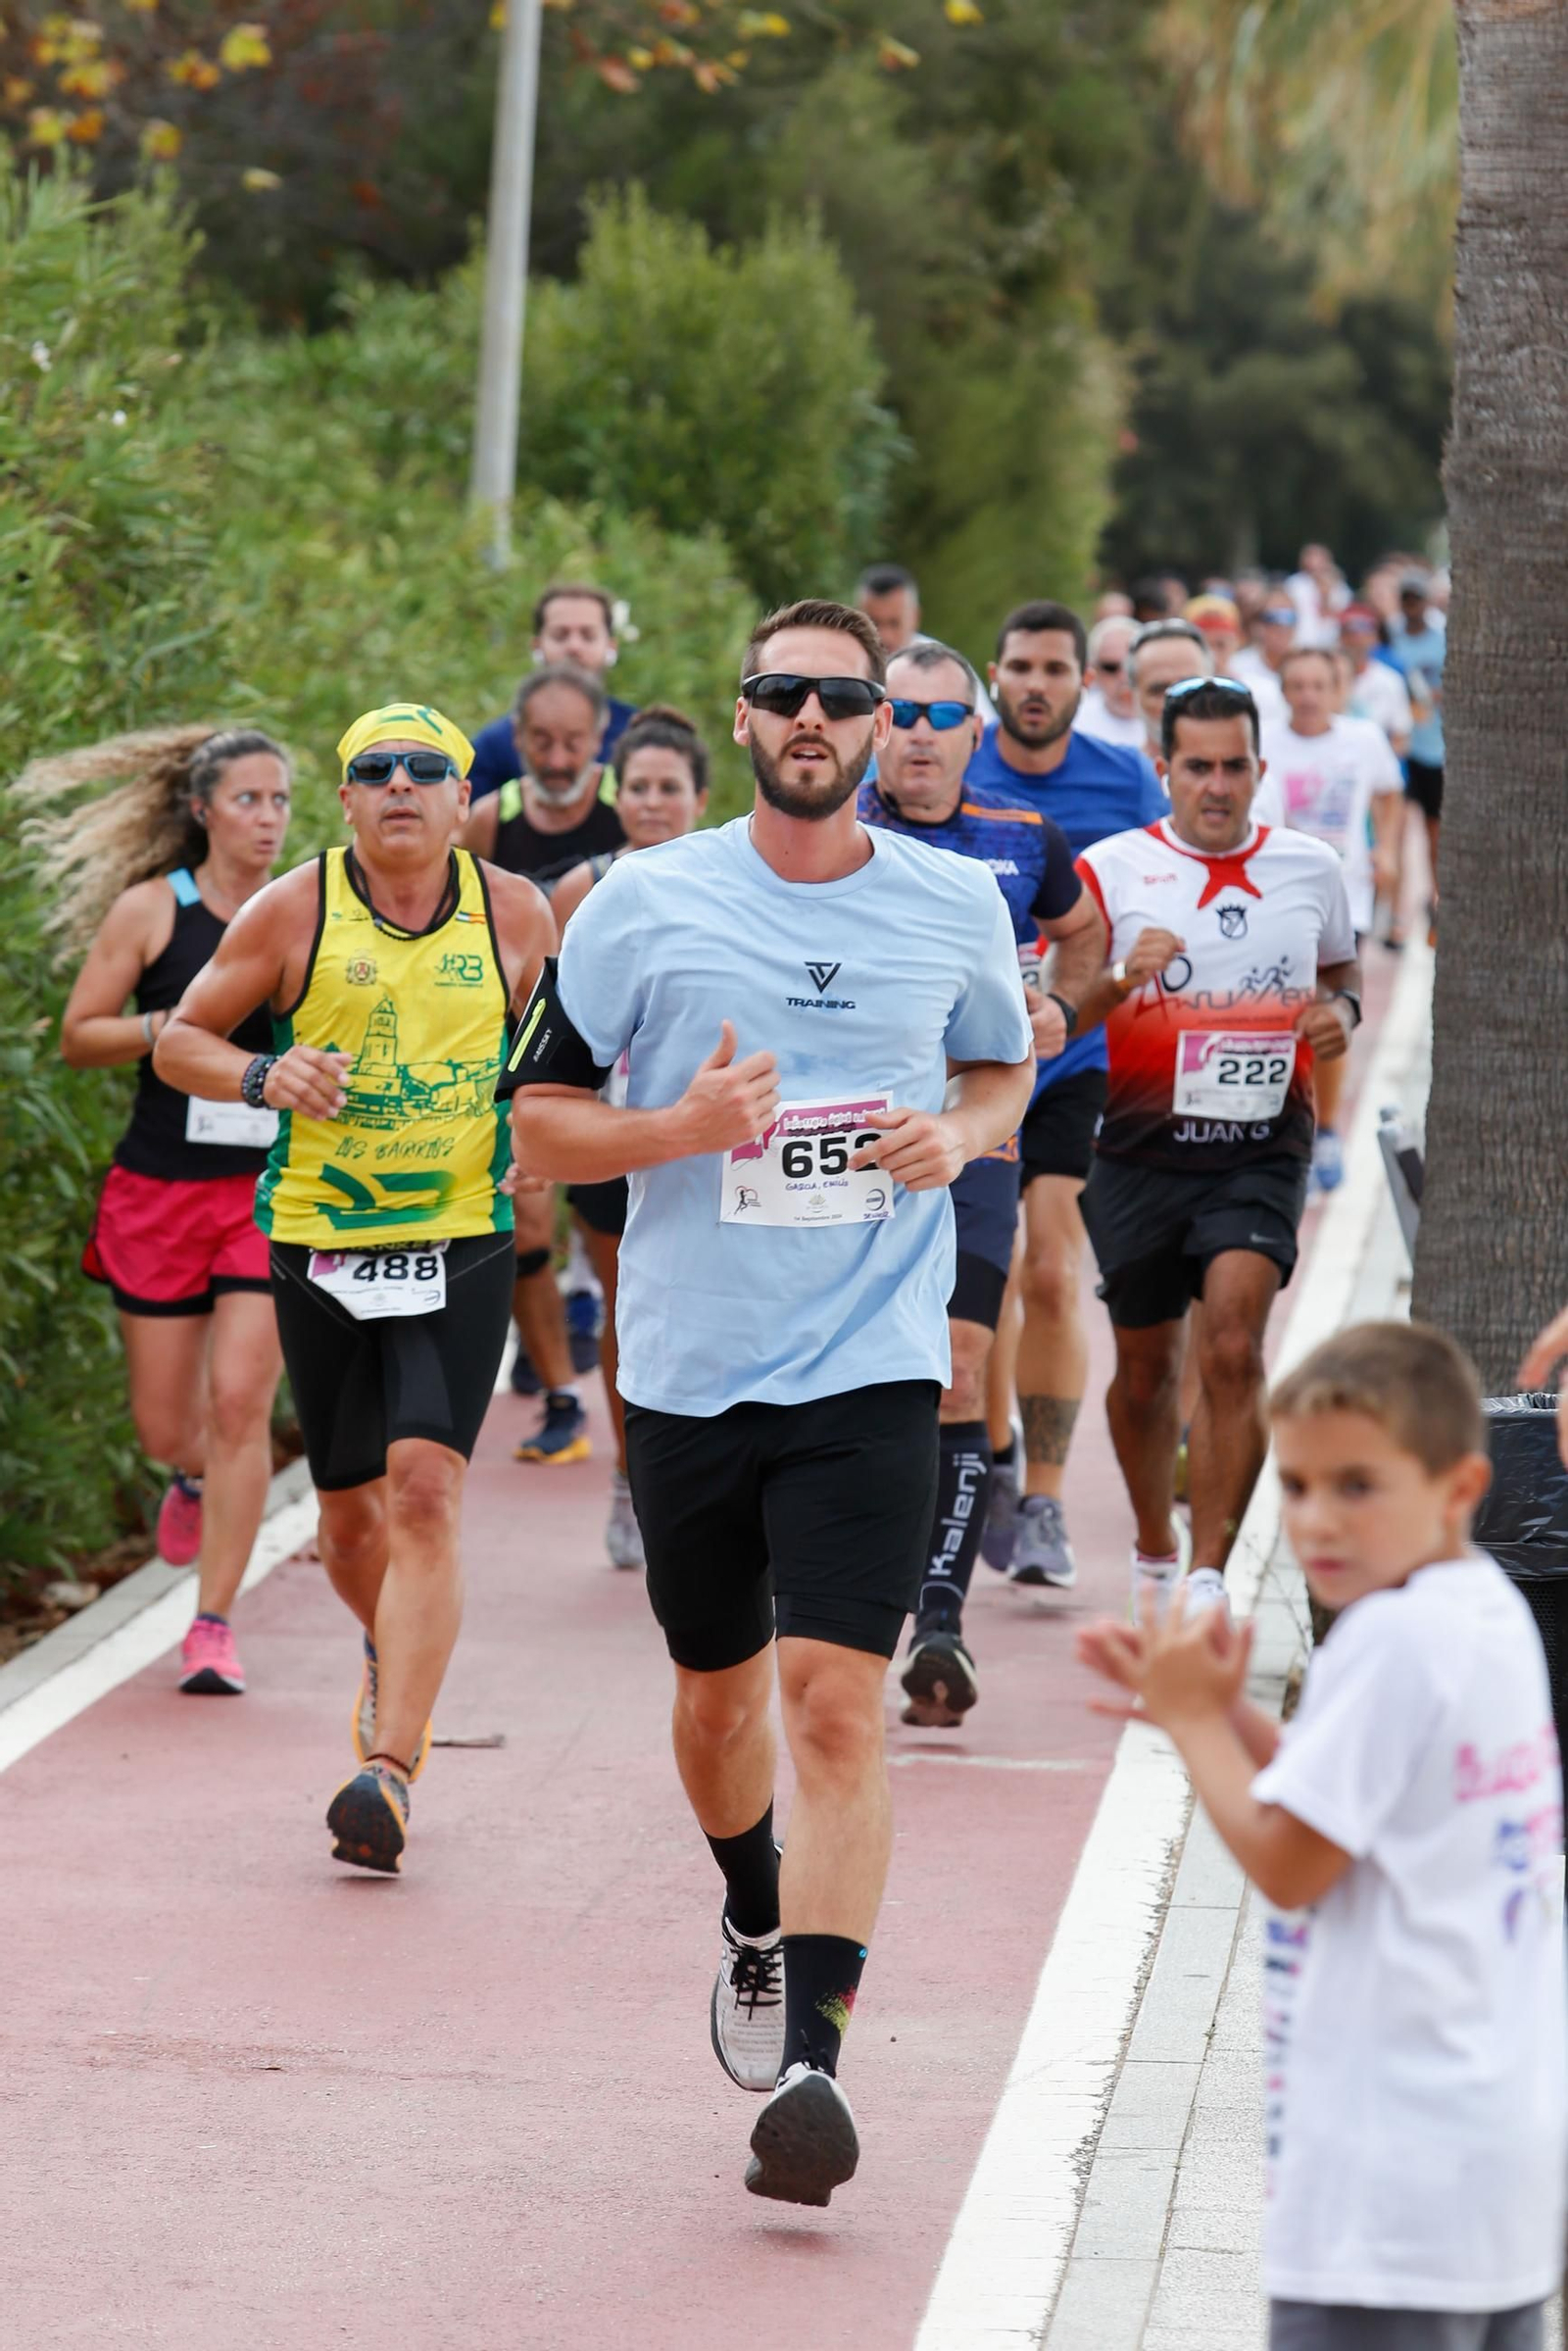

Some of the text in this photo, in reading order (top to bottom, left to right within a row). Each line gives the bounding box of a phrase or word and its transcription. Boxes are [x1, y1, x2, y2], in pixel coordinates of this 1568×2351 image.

[983, 858, 1020, 875] OKA
[786, 997, 857, 1009] TRAINING
[1218, 1059, 1287, 1084] 222
[1173, 1120, 1245, 1143] JUAN
[335, 1136, 455, 1160] LOS BARRIOS
[353, 1254, 438, 1282] 488
[928, 1452, 988, 1576] Kalenji
